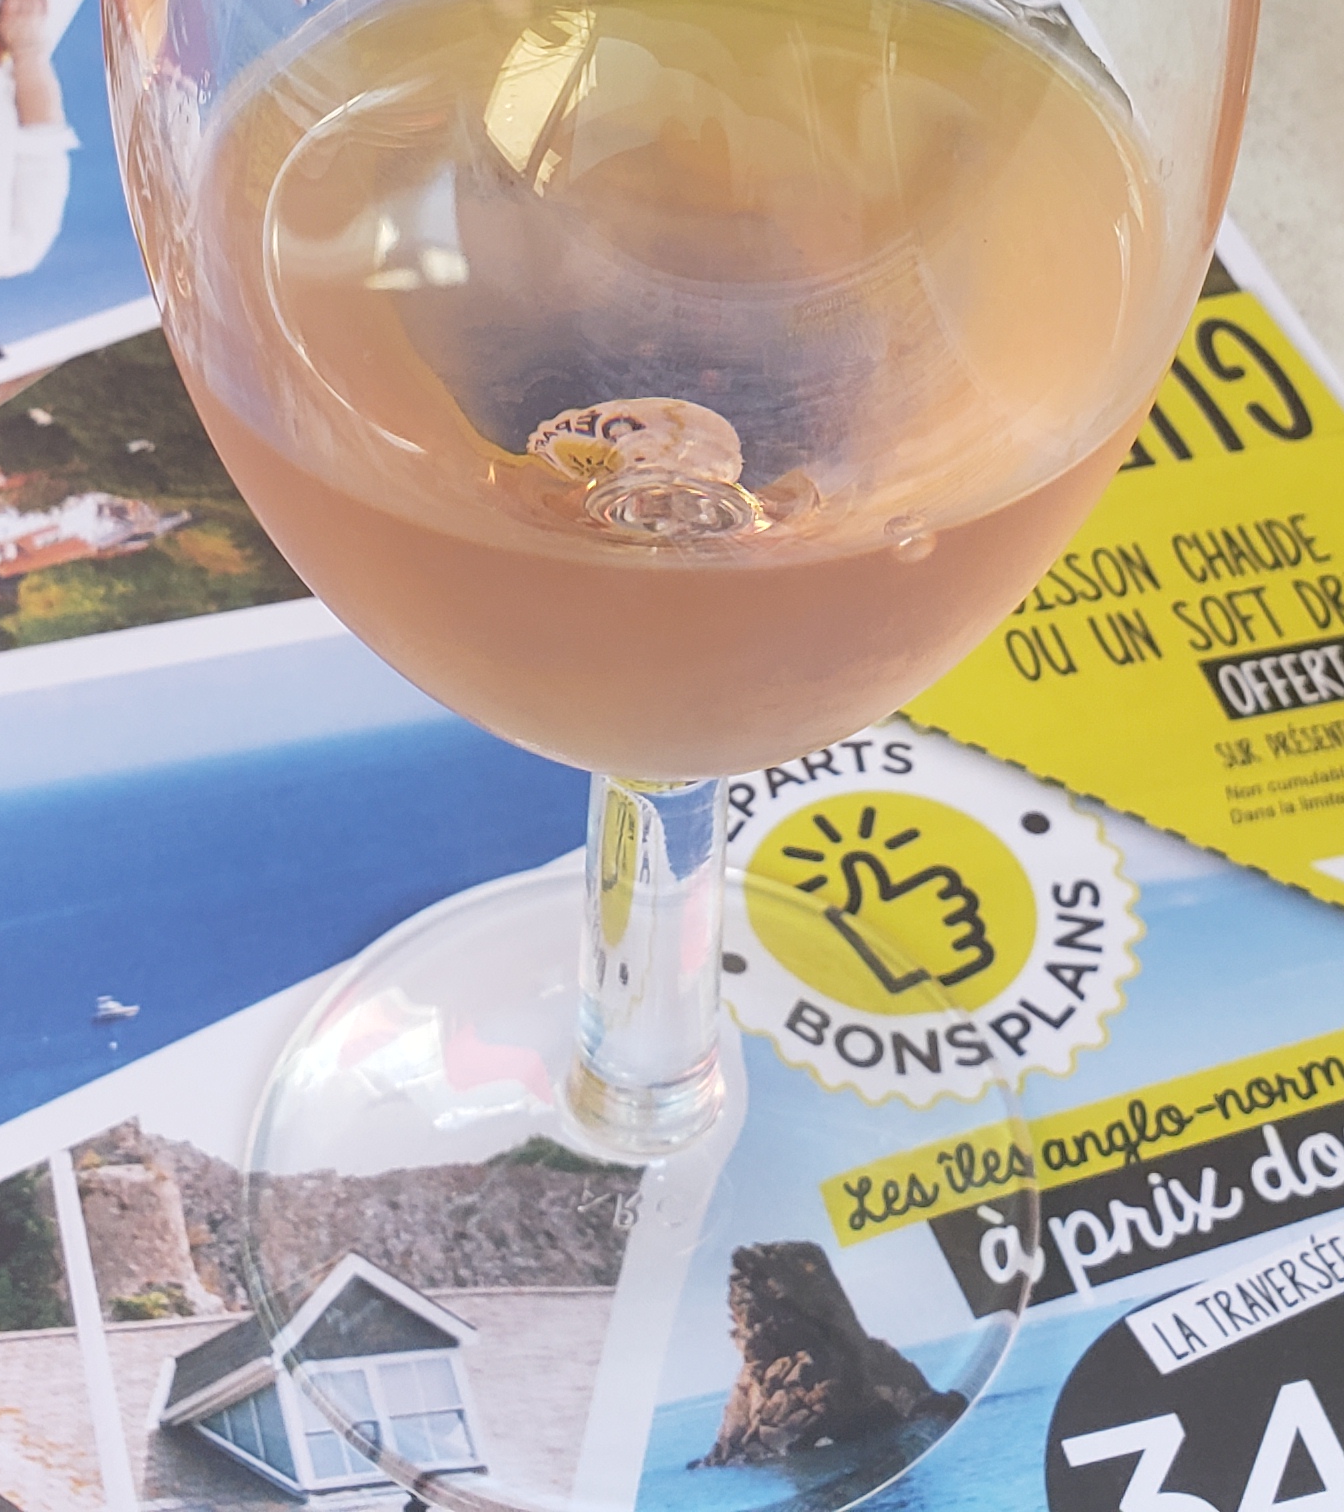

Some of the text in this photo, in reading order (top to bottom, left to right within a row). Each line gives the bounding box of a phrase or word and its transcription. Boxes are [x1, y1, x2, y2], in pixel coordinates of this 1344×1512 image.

[1171, 513, 1333, 584] CHAUDE
[1005, 622, 1079, 682] OU
[1087, 608, 1164, 667] UN
[1171, 585, 1286, 653] SOFT
[1213, 736, 1260, 772] SUR
[728, 740, 914, 841] PARTS
[1225, 783, 1263, 804] Non
[1229, 802, 1276, 826] Dans
[1278, 798, 1296, 817] la
[843, 1174, 941, 1232] Les
[936, 1140, 1037, 1192] îles
[978, 1204, 1045, 1286] à
[1050, 1166, 1245, 1303] prix
[1151, 1307, 1207, 1361] LA
